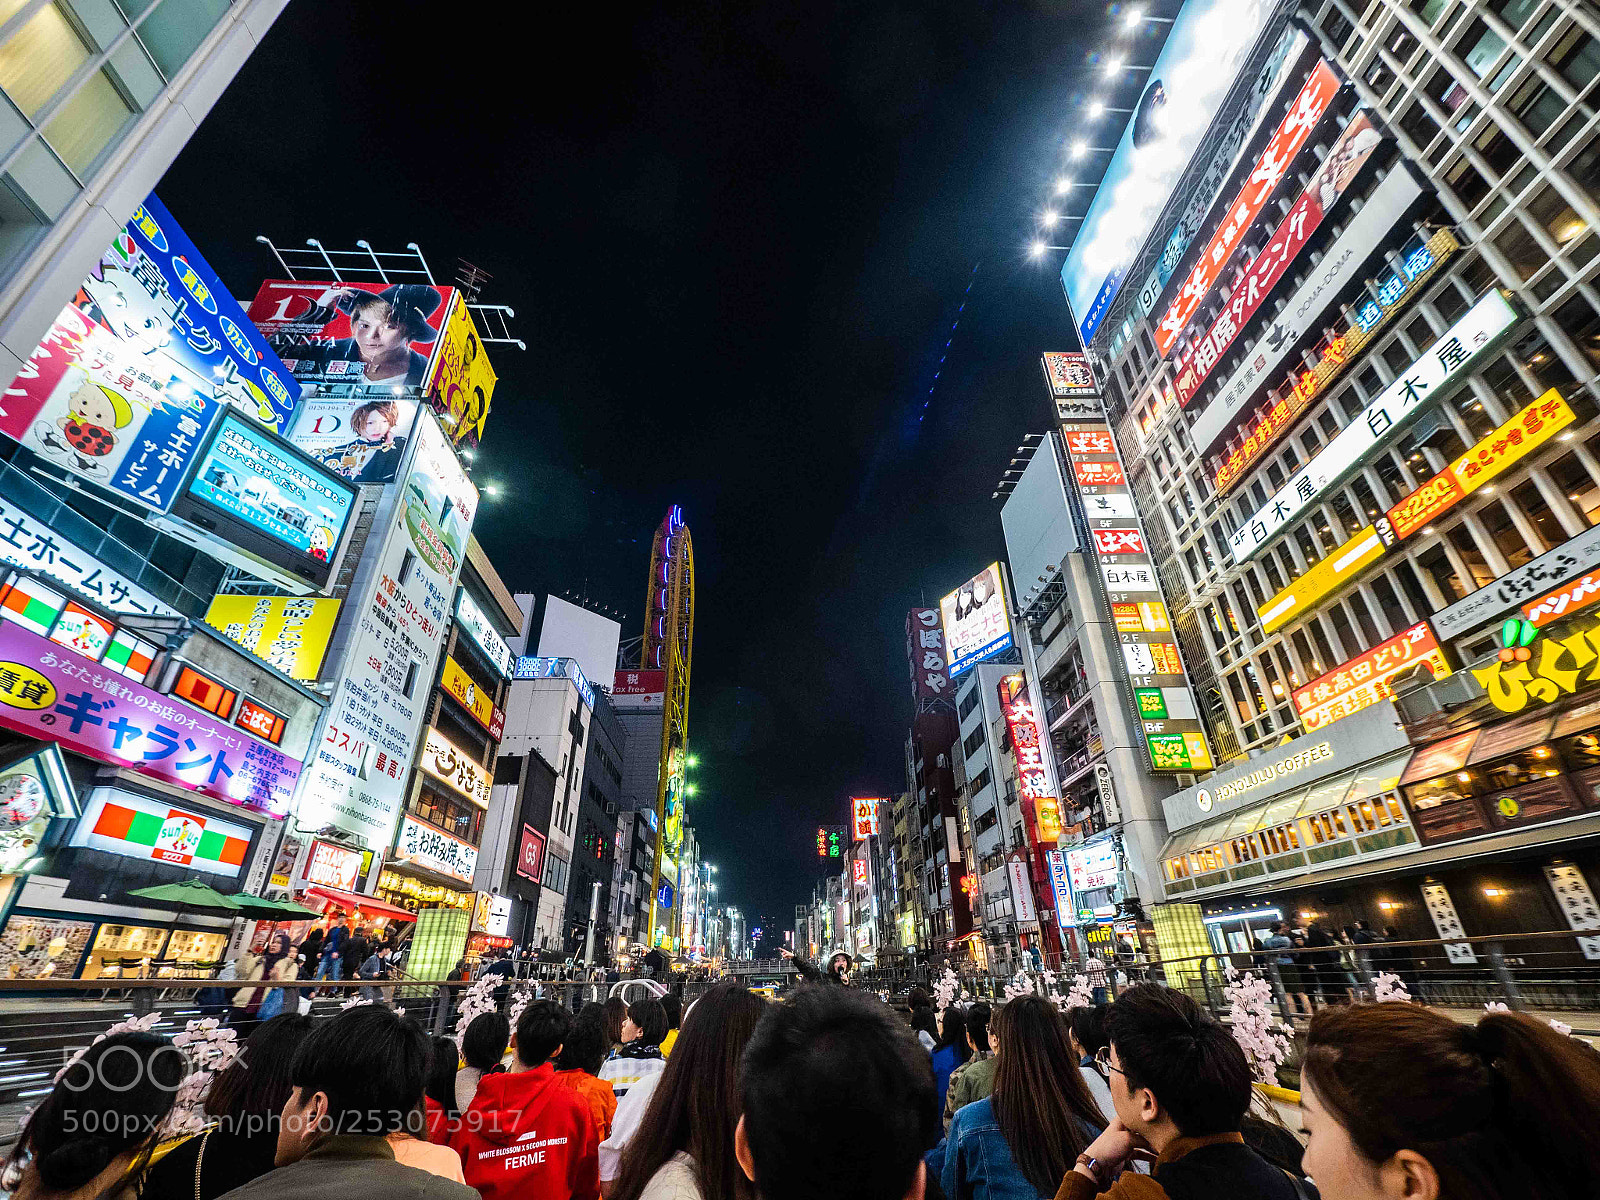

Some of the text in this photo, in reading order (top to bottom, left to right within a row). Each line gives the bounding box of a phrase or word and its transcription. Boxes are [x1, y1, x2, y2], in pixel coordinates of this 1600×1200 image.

[1142, 279, 1163, 308] 9F
[1232, 335, 1472, 549] 4F 白木屋 白木屋
[1100, 520, 1113, 528] 5F
[1376, 517, 1396, 548] 3F
[1101, 555, 1118, 564] 4F
[1106, 569, 1151, 583] 白木屋
[1111, 593, 1128, 602] 3F
[1121, 633, 1139, 643] 2F
[1406, 622, 1428, 644] 2F
[1133, 676, 1152, 686] 1F
[238, 703, 272, 735] たばこ
[1214, 741, 1335, 802] HONOLULU COFFEE
[478, 1149, 495, 1160] WHITE
[496, 1145, 521, 1157] BLOSSOM
[526, 1139, 546, 1150] SECOND
[547, 1136, 568, 1146] MONSTER
[504, 1150, 546, 1170] FERME
